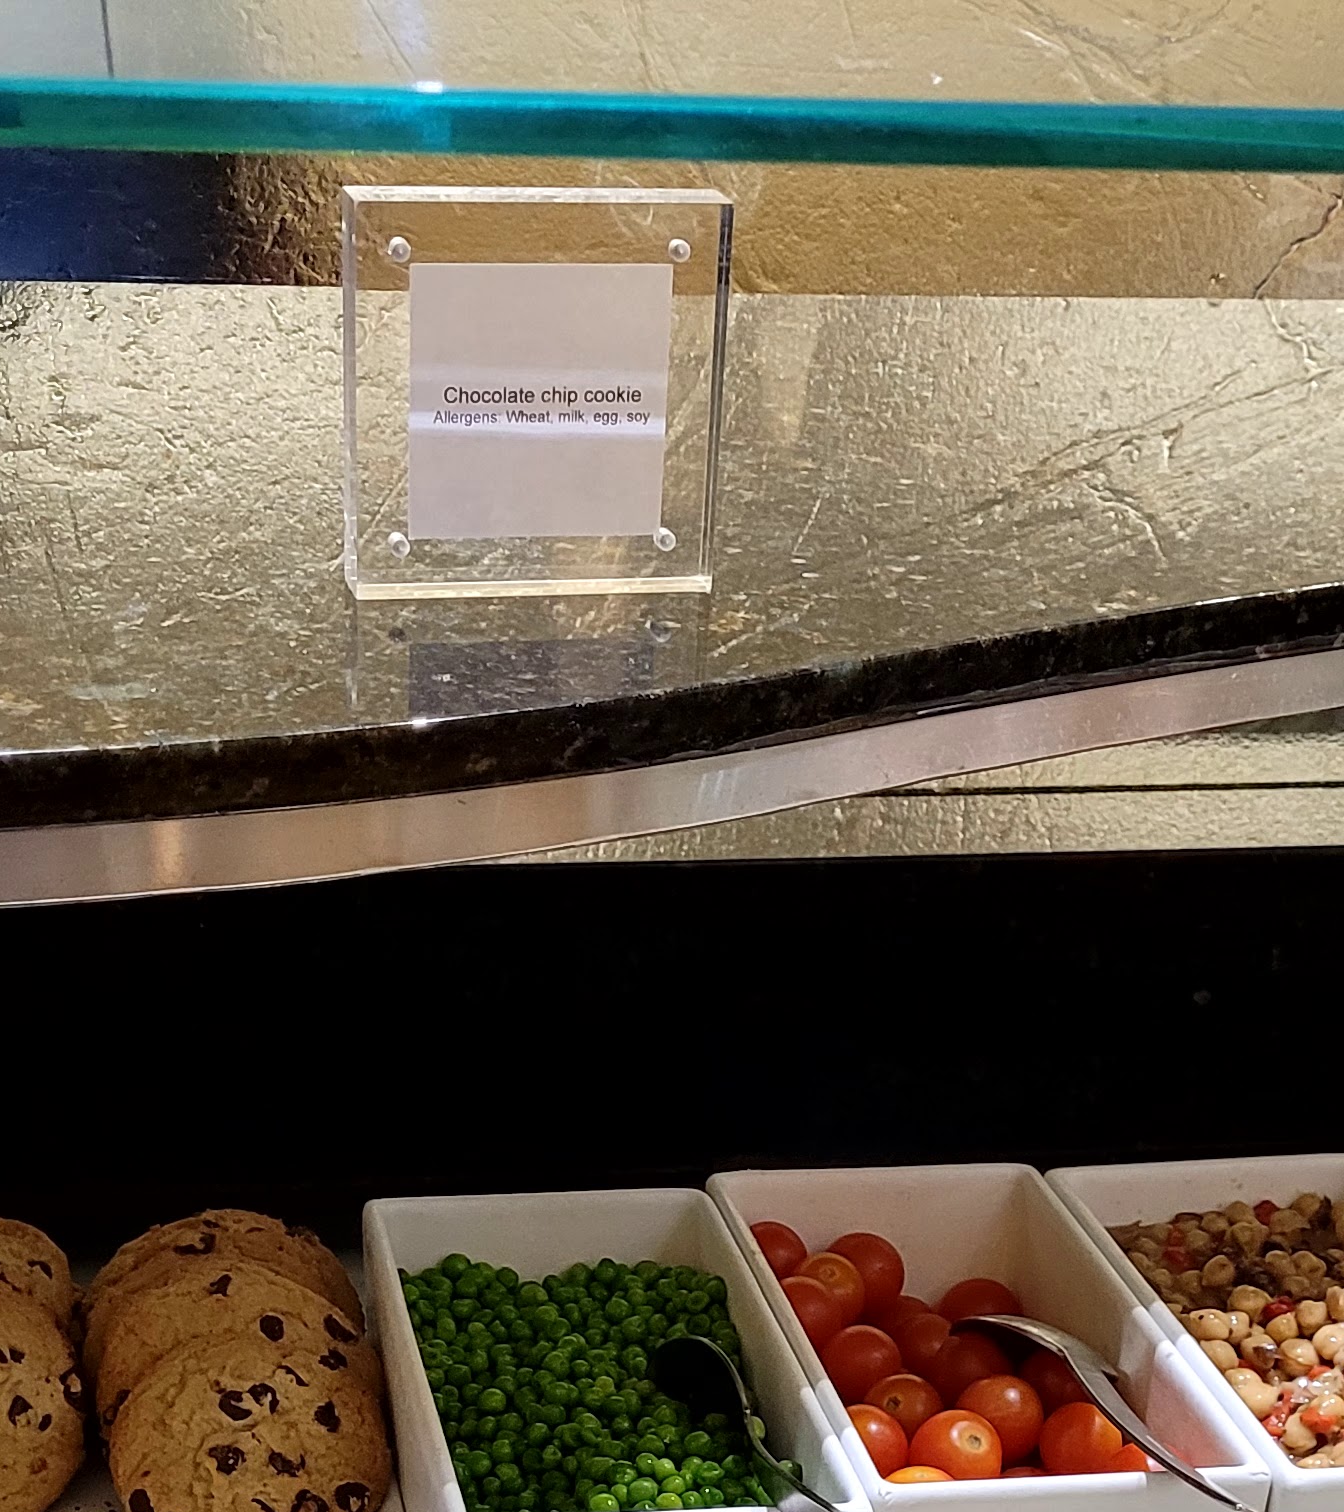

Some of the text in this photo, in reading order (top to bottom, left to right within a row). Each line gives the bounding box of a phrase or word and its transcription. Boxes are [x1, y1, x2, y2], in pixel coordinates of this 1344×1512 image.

[443, 386, 642, 407] Chocolate chip cookie
[433, 410, 650, 426] Allergens: Wheat, milk, egg, soy
